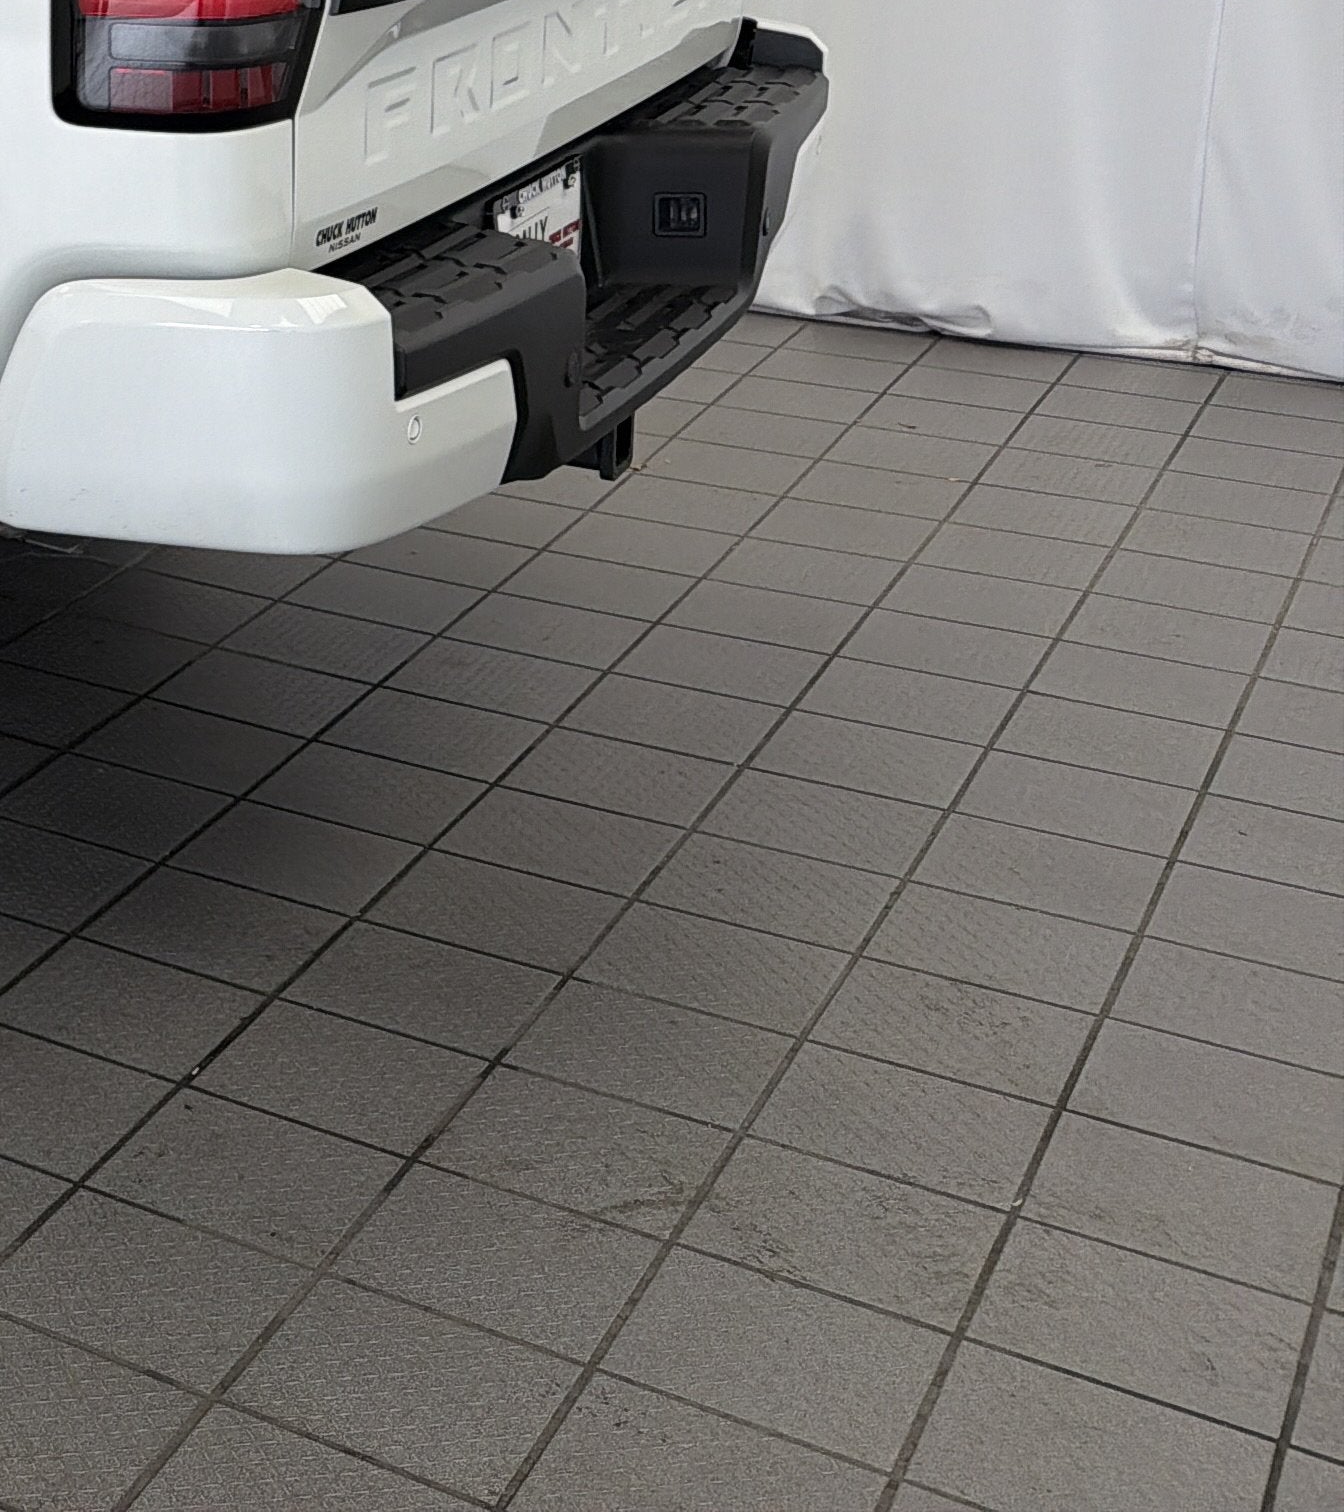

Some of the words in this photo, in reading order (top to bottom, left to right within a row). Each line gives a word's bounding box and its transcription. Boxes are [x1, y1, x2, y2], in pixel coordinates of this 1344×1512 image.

[316, 221, 344, 247] CHUCK
[345, 207, 378, 235] HUTTON
[328, 232, 361, 253] NISSAN
